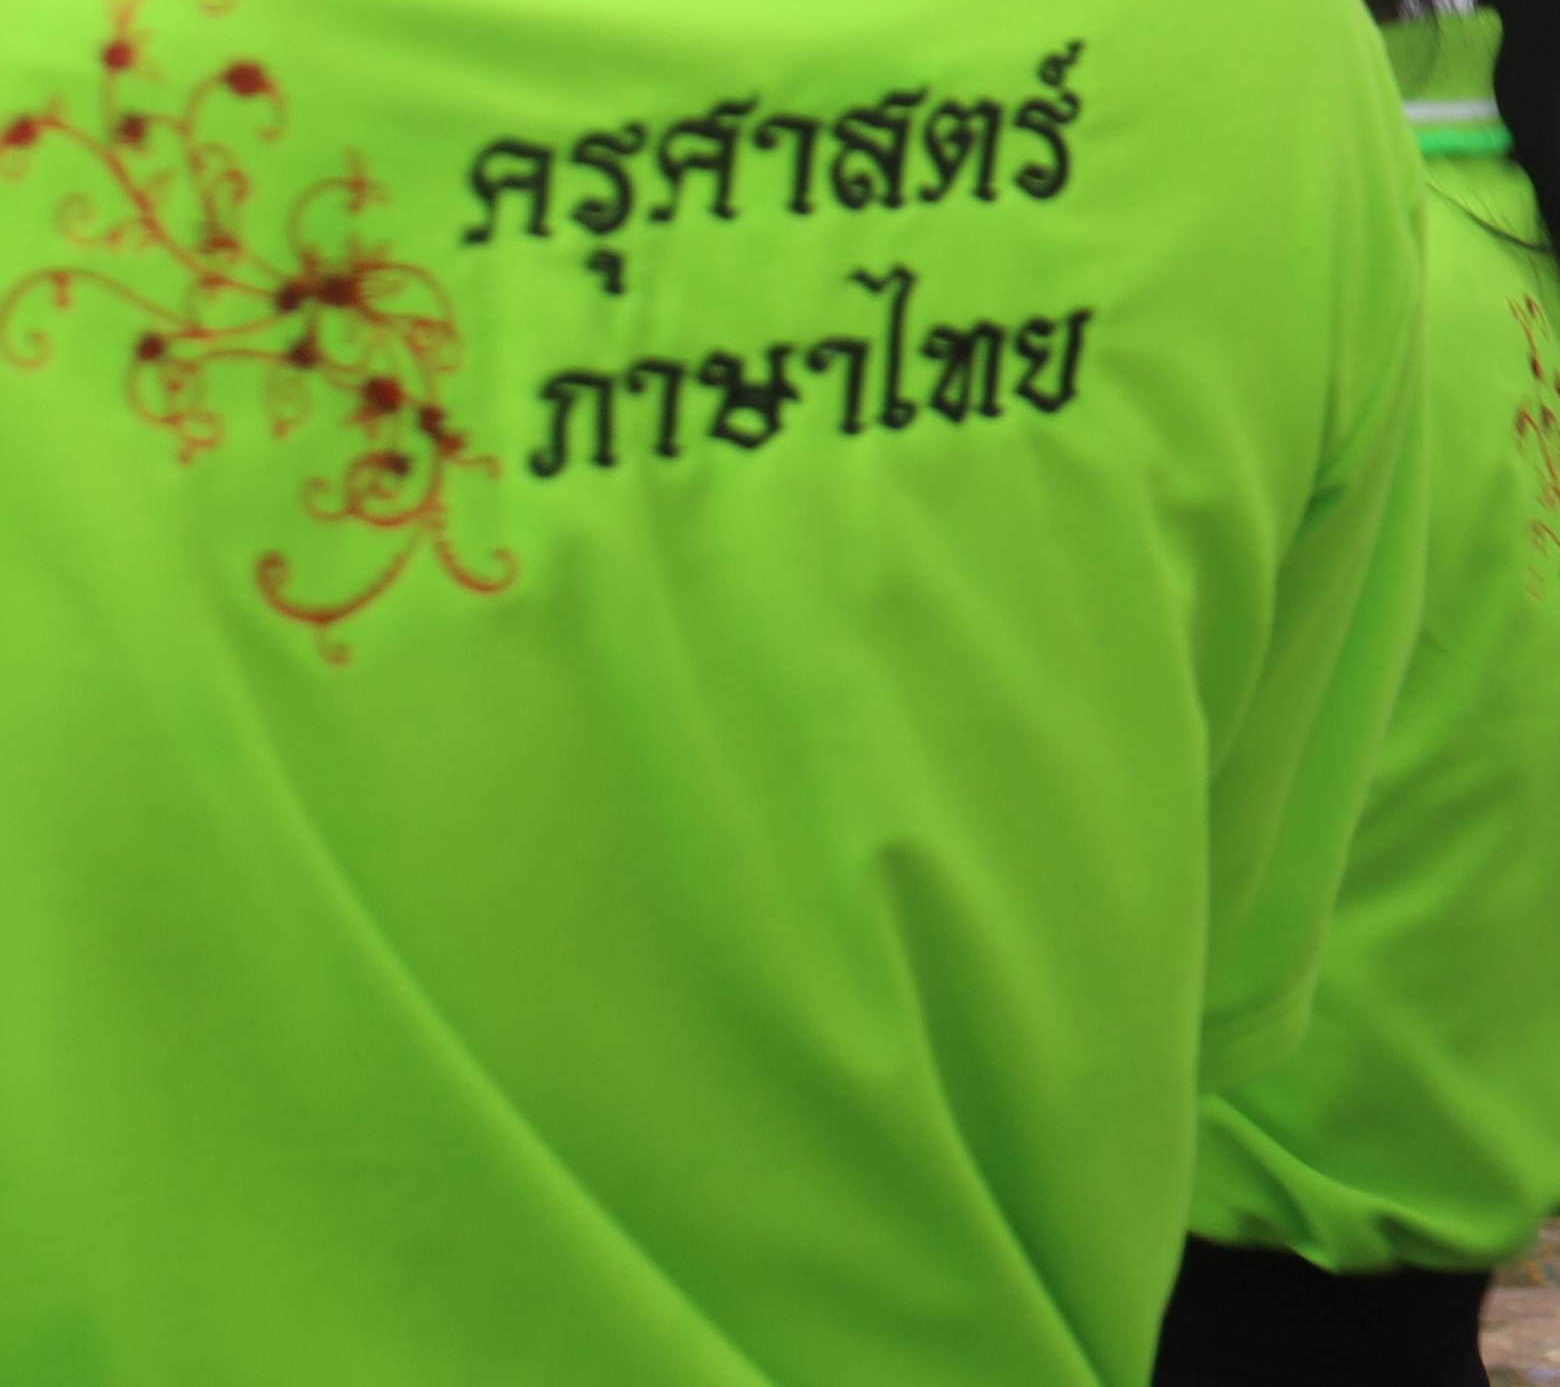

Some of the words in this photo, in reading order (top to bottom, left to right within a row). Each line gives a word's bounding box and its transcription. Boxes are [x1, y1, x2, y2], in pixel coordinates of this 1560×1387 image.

[461, 40, 1085, 296] ครุศาสตร์
[528, 263, 1094, 478] ภาษาไทย
